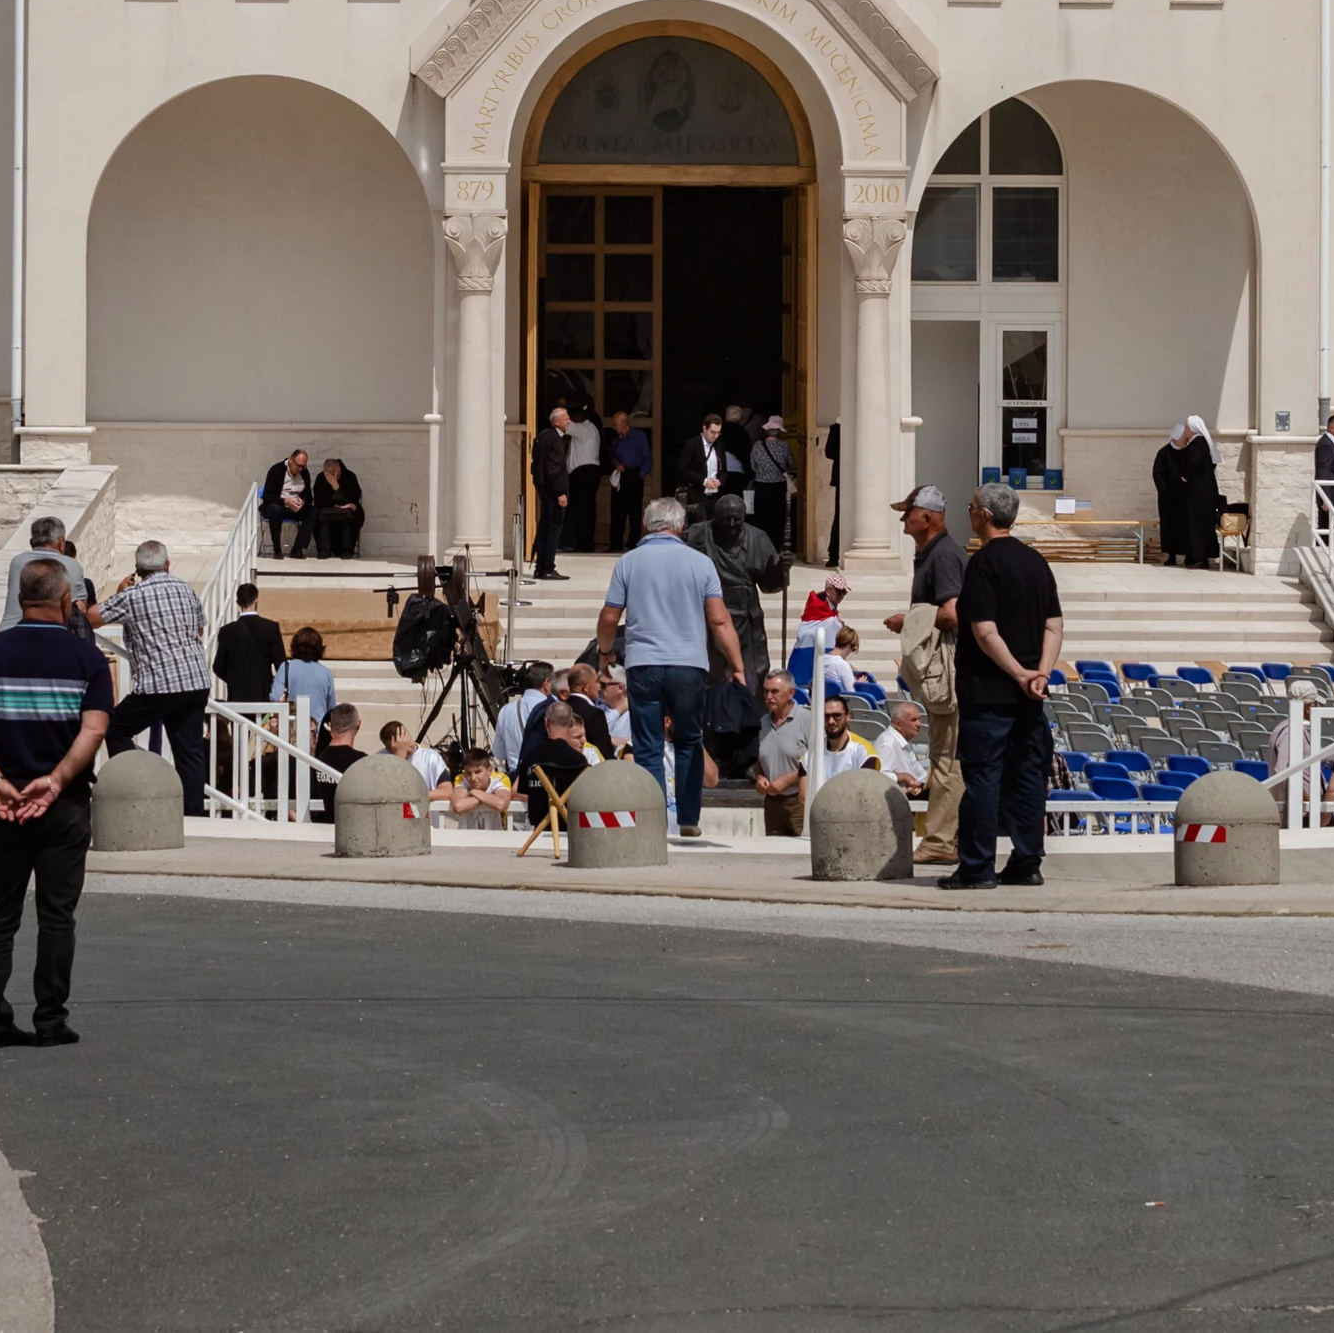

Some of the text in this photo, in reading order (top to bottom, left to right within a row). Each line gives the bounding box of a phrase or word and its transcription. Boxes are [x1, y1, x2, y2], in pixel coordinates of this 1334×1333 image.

[470, 30, 540, 154] MARTYRIBUS
[804, 25, 881, 157] MUČENICIMA
[457, 180, 494, 203] 879
[852, 183, 900, 204] 2010
